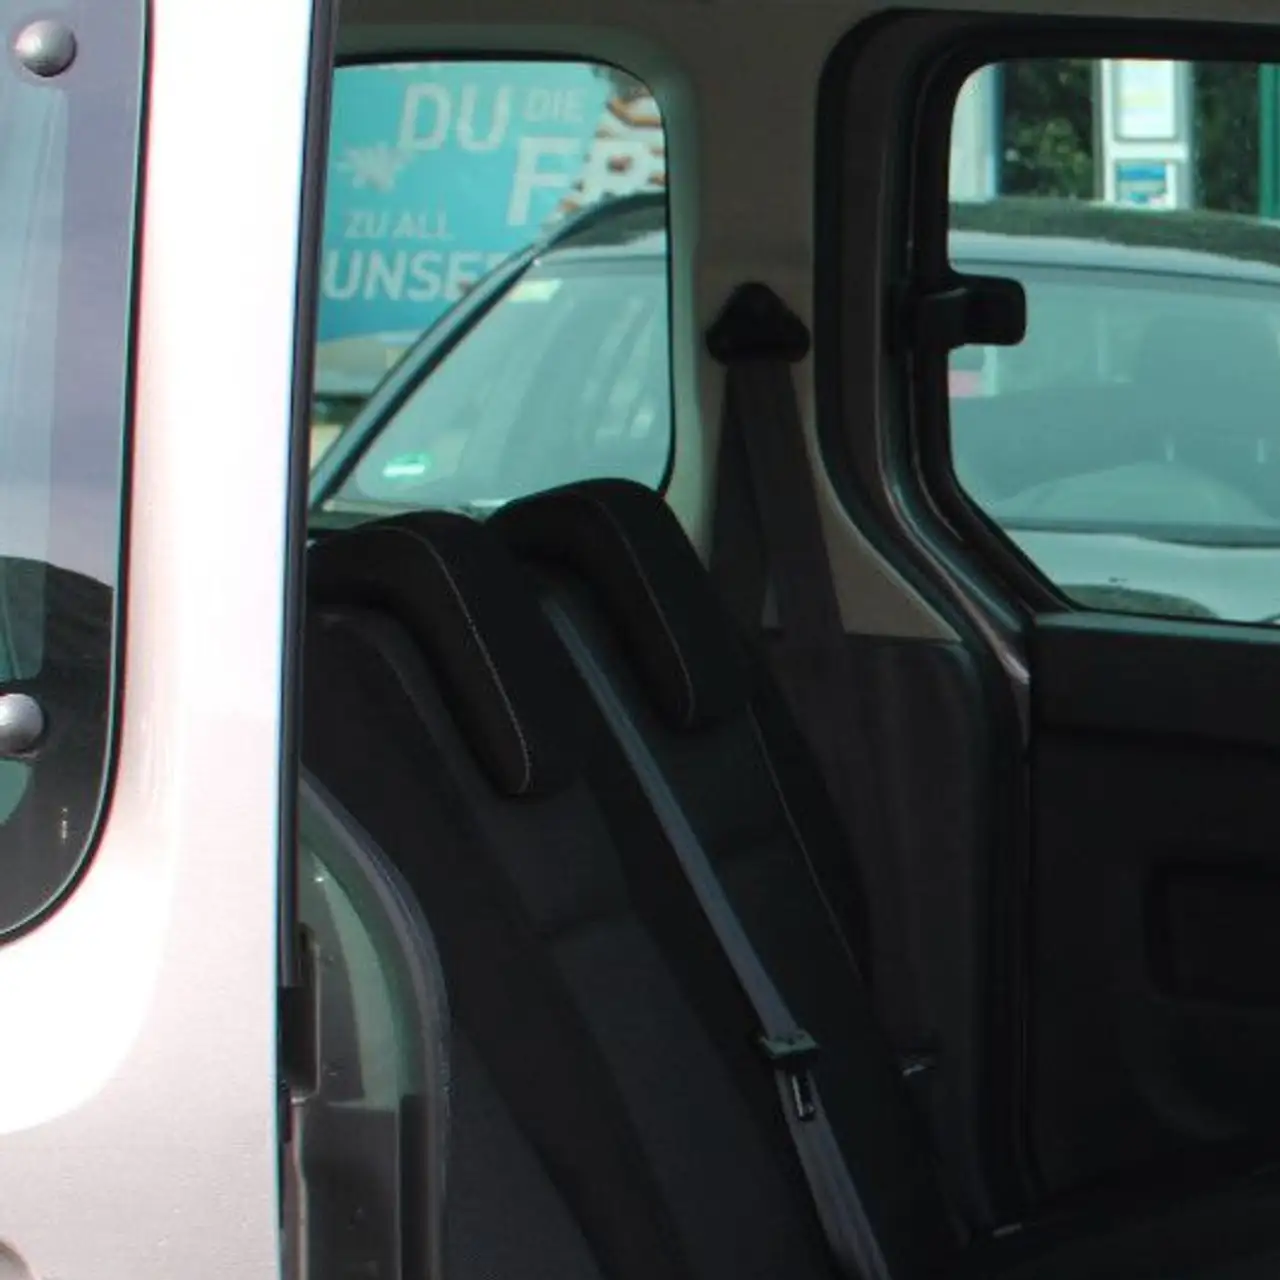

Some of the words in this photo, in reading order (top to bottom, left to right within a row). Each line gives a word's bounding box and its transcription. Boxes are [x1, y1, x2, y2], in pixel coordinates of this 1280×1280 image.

[398, 82, 515, 154] DU
[344, 209, 388, 239] ZU
[322, 249, 507, 300] UNSE
